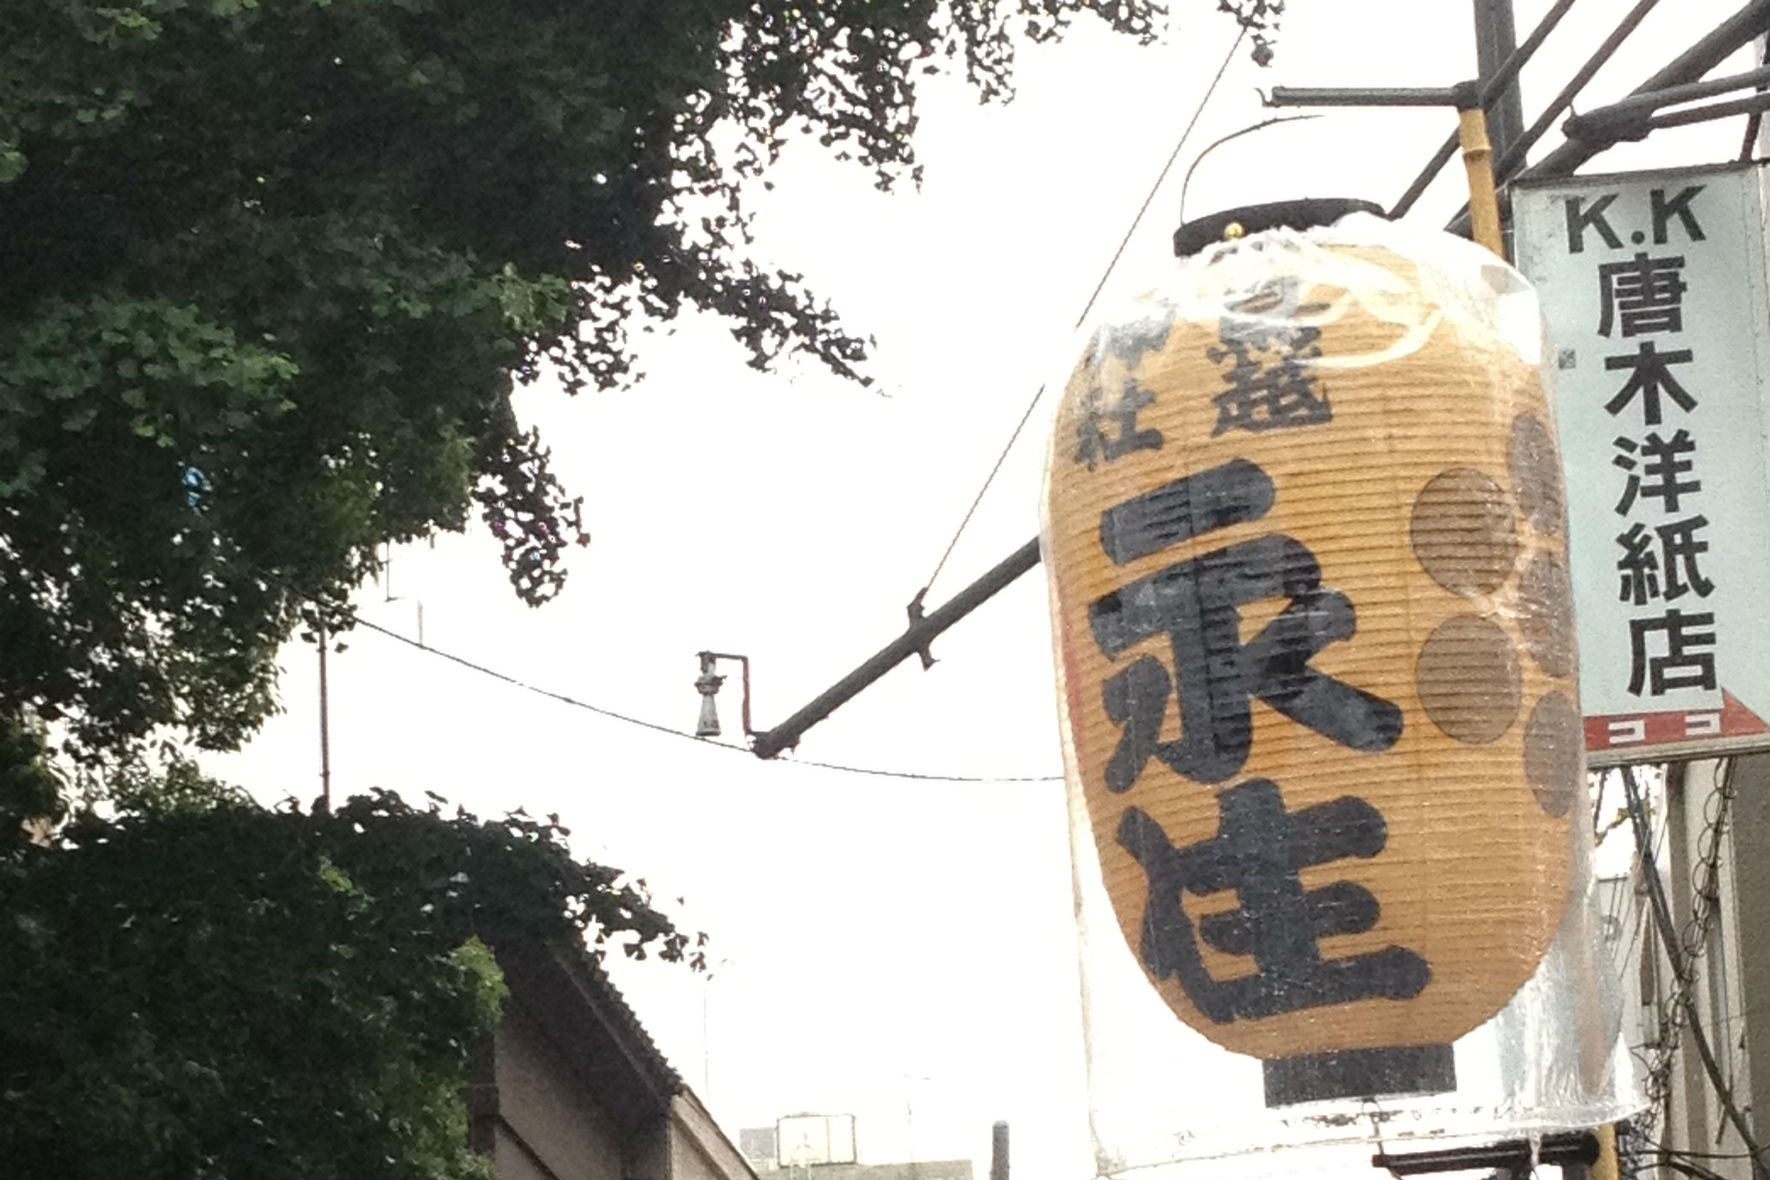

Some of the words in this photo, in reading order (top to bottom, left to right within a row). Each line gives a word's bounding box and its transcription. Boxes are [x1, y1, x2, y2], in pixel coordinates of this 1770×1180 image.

[1565, 184, 1708, 254] K.K
[1597, 252, 1718, 697] 唐木洋紙店
